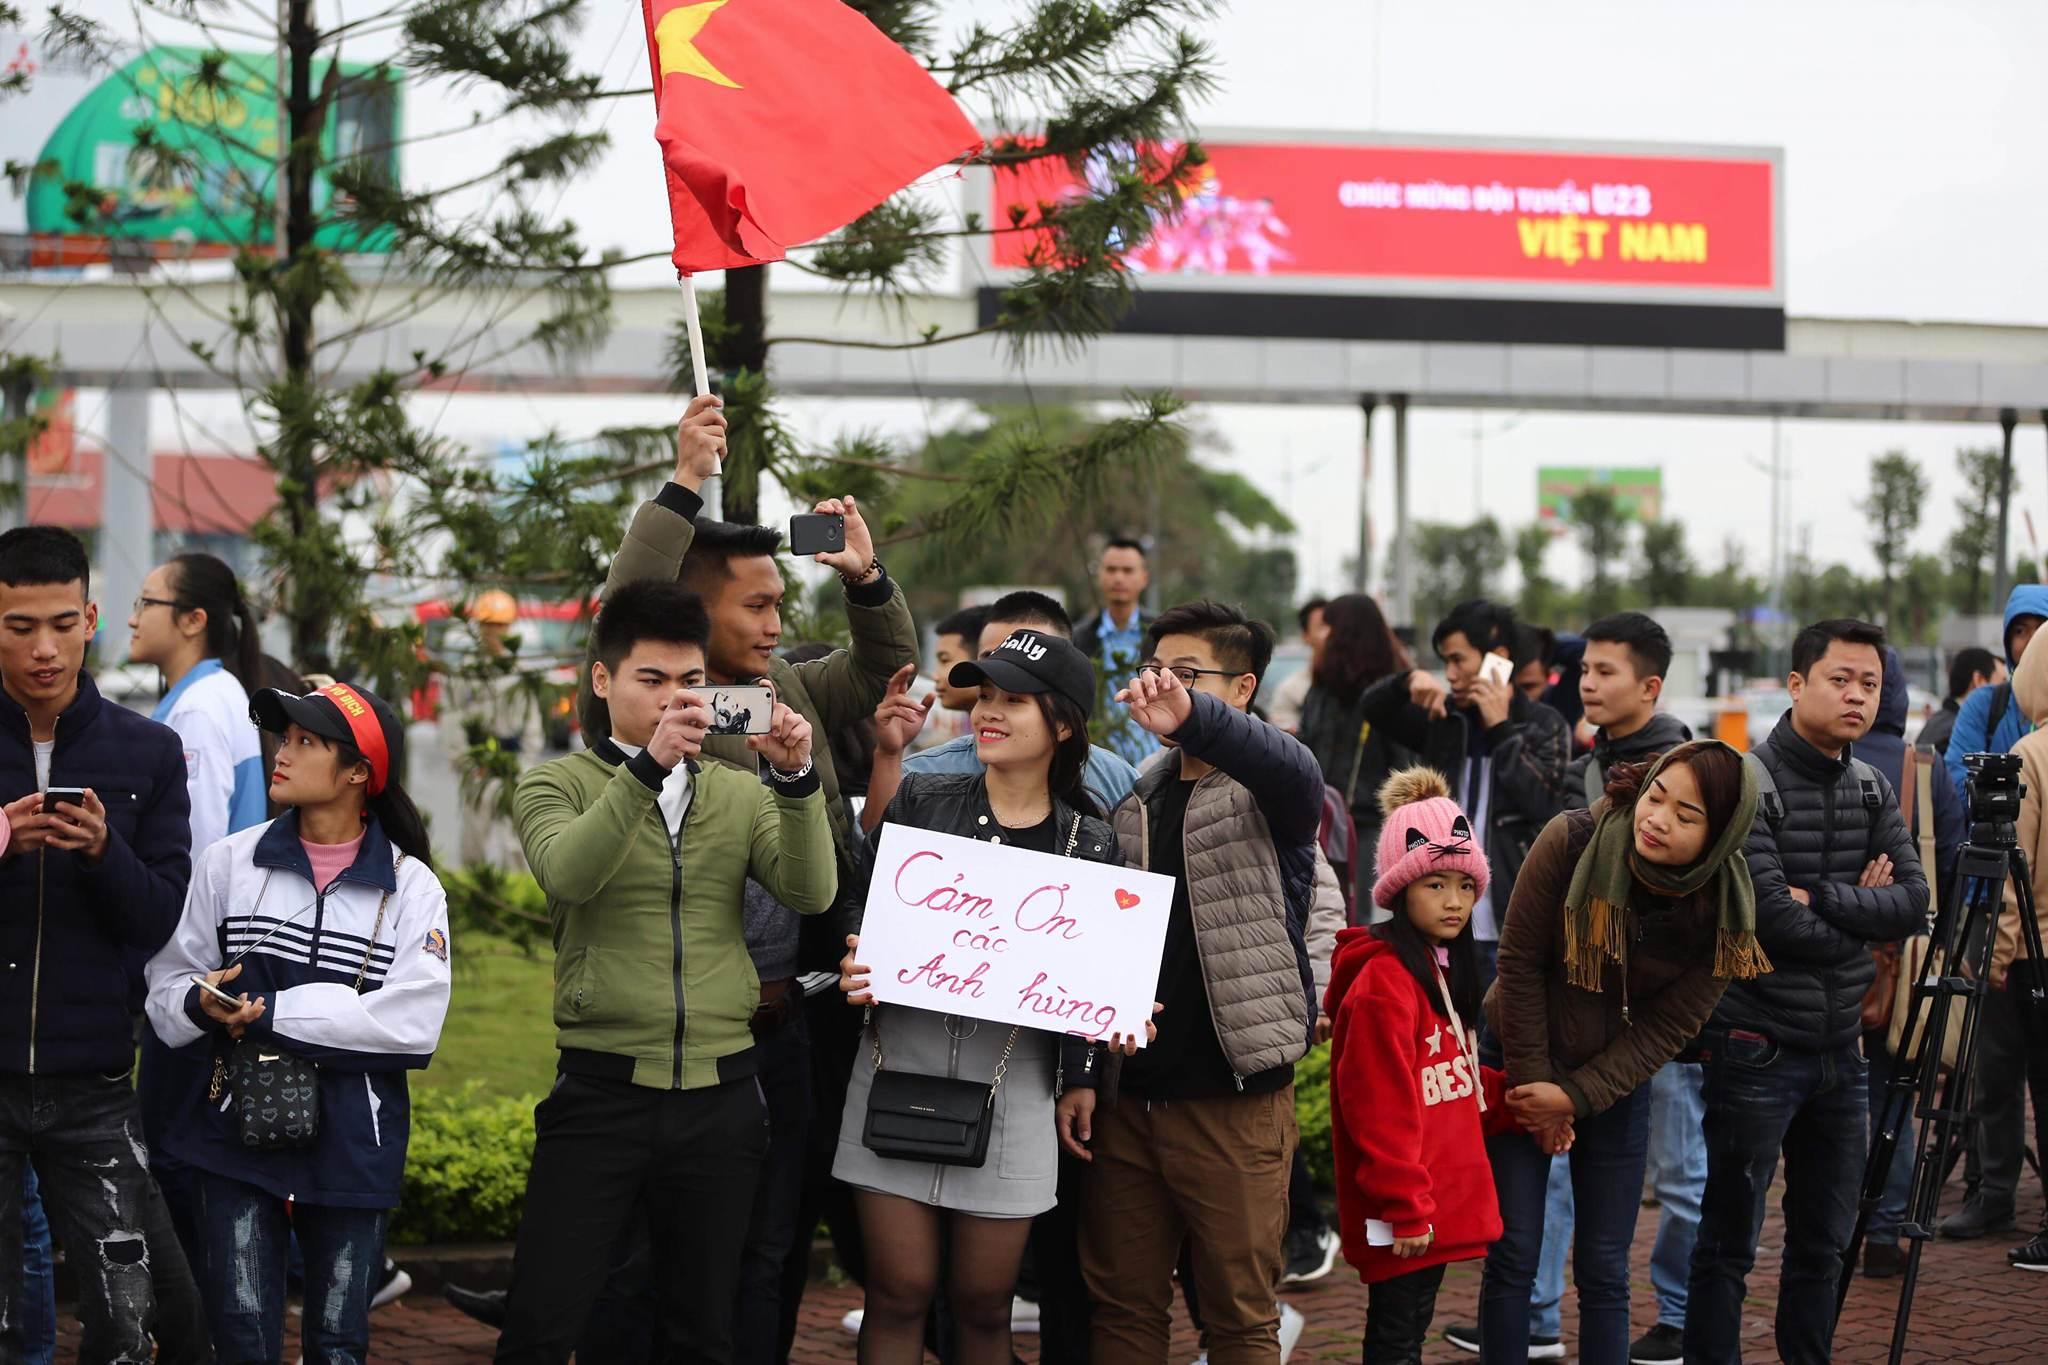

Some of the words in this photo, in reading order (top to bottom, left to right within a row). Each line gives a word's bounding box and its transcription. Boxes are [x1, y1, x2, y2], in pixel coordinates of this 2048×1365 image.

[1592, 183, 1651, 216] U23
[1517, 211, 1609, 266] VIỆT
[1619, 221, 1708, 263] NAM
[1407, 837, 1425, 851] PHOTO
[1453, 829, 1469, 837] PHOTO
[894, 851, 994, 919] Cảm
[952, 925, 1010, 953] các
[897, 953, 991, 998] Anh
[1018, 971, 1116, 1037] hùng
[1421, 1054, 1474, 1106] BES
